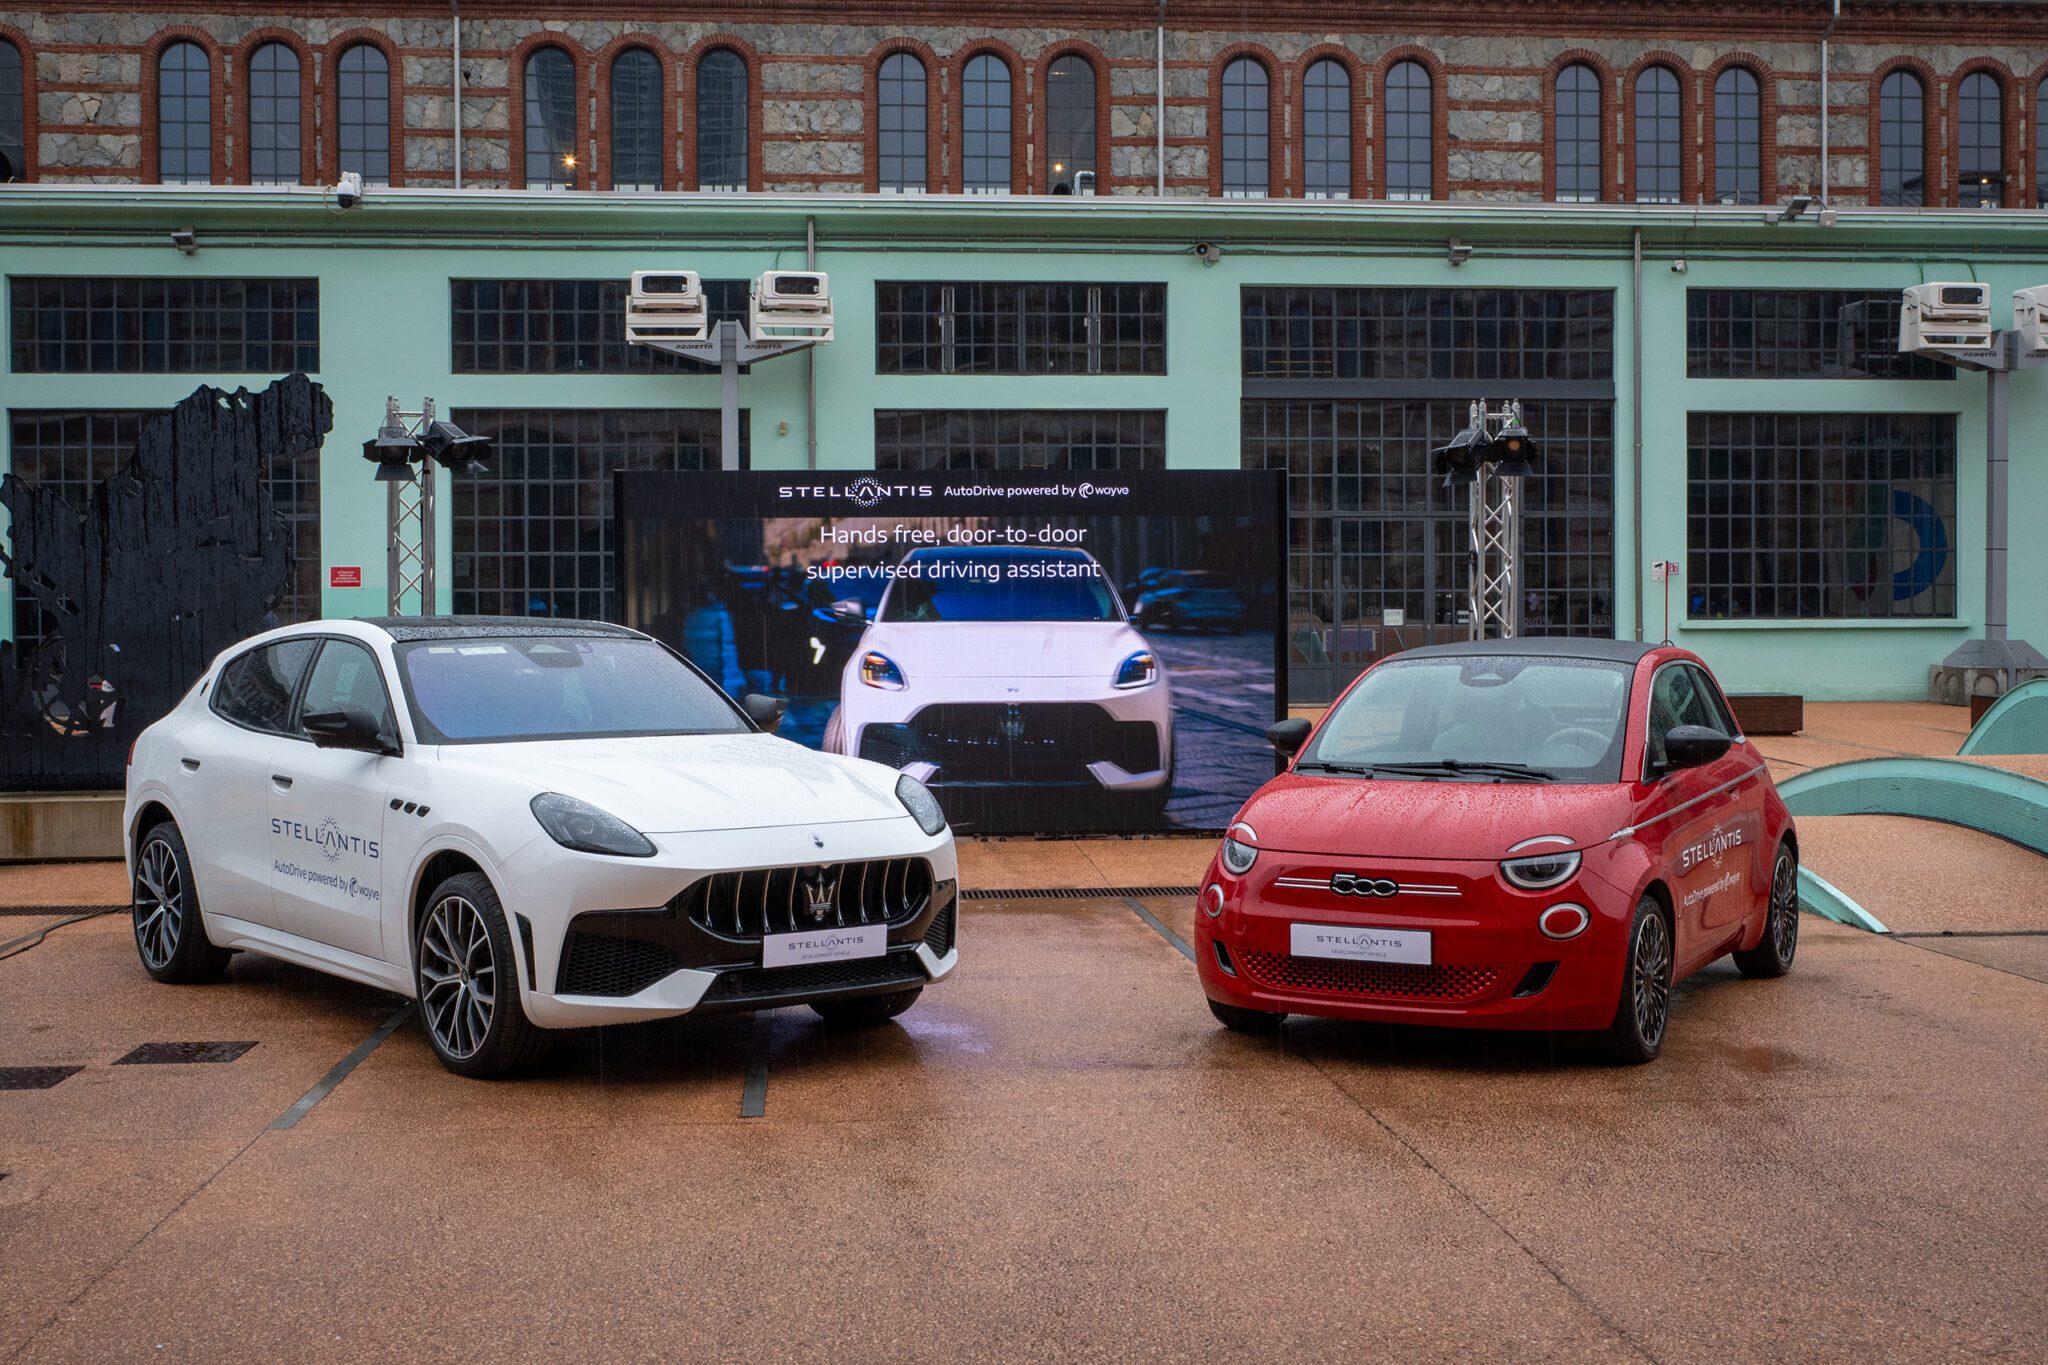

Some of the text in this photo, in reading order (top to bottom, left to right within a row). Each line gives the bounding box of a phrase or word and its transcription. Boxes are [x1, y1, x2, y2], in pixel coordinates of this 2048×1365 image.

[779, 484, 1130, 499] STELLANTIS AutoDrive powered by wayve
[820, 523, 1088, 546] Hands free, door-to-door
[806, 559, 1101, 584] supervised driving assistant
[271, 818, 379, 859] STELLANTIS
[1682, 829, 1742, 868] STELLANTIS
[273, 859, 380, 901] AutoDrive powered by wayve
[1332, 873, 1397, 897] 500
[788, 936, 864, 951] STELLANTIS
[1316, 935, 1403, 948] STELLANTIS
[1331, 948, 1367, 957] DEVELOPMENT
